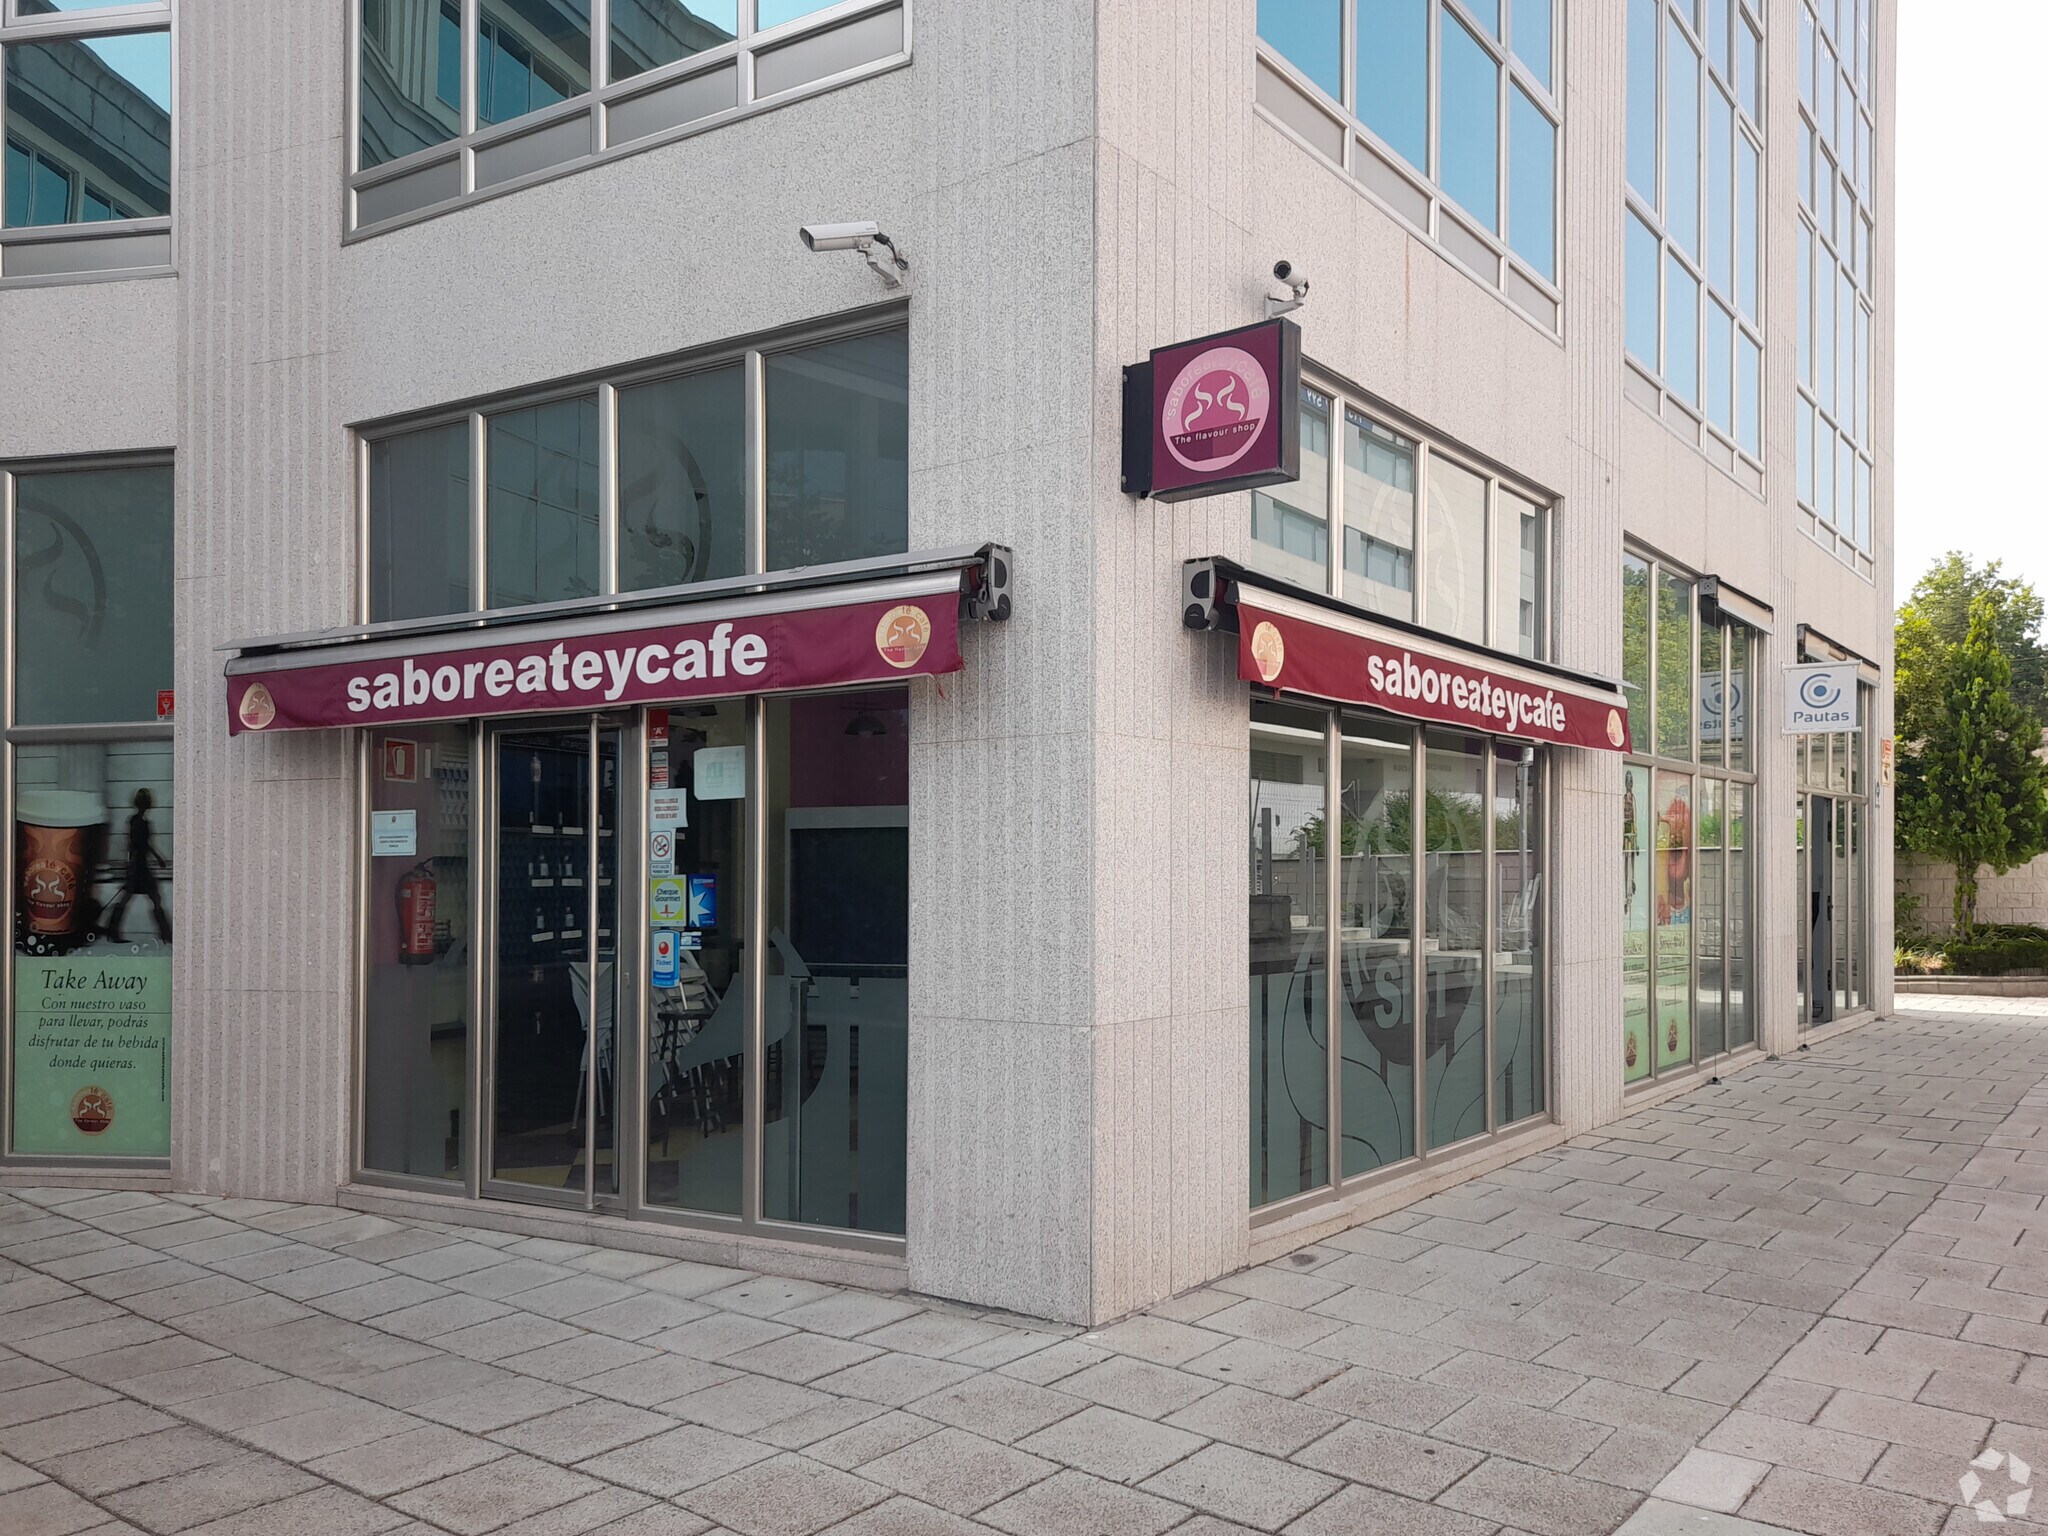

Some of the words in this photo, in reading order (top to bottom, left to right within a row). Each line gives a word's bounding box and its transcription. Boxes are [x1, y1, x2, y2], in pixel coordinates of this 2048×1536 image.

[1174, 436, 1192, 445] The
[1195, 427, 1229, 441] flavour
[1232, 422, 1256, 435] shop
[347, 622, 768, 713] saboreateycafe
[1367, 652, 1566, 732] saboreateycafe
[1793, 711, 1850, 723] Pautas
[656, 888, 679, 896] Cheque
[41, 969, 87, 989] Take
[93, 970, 148, 995] Away
[41, 996, 66, 1010] Con
[70, 999, 115, 1010] nuestro
[119, 1001, 146, 1010] vaso
[39, 1016, 65, 1030] para
[69, 1014, 104, 1030] llevar,
[107, 1014, 149, 1030] podrás
[28, 1034, 80, 1050] disfrutar
[84, 1034, 98, 1048] de
[101, 1037, 114, 1048] tu
[118, 1035, 159, 1049] bebida
[49, 1054, 87, 1068] donde
[90, 1056, 137, 1071] quieras.
